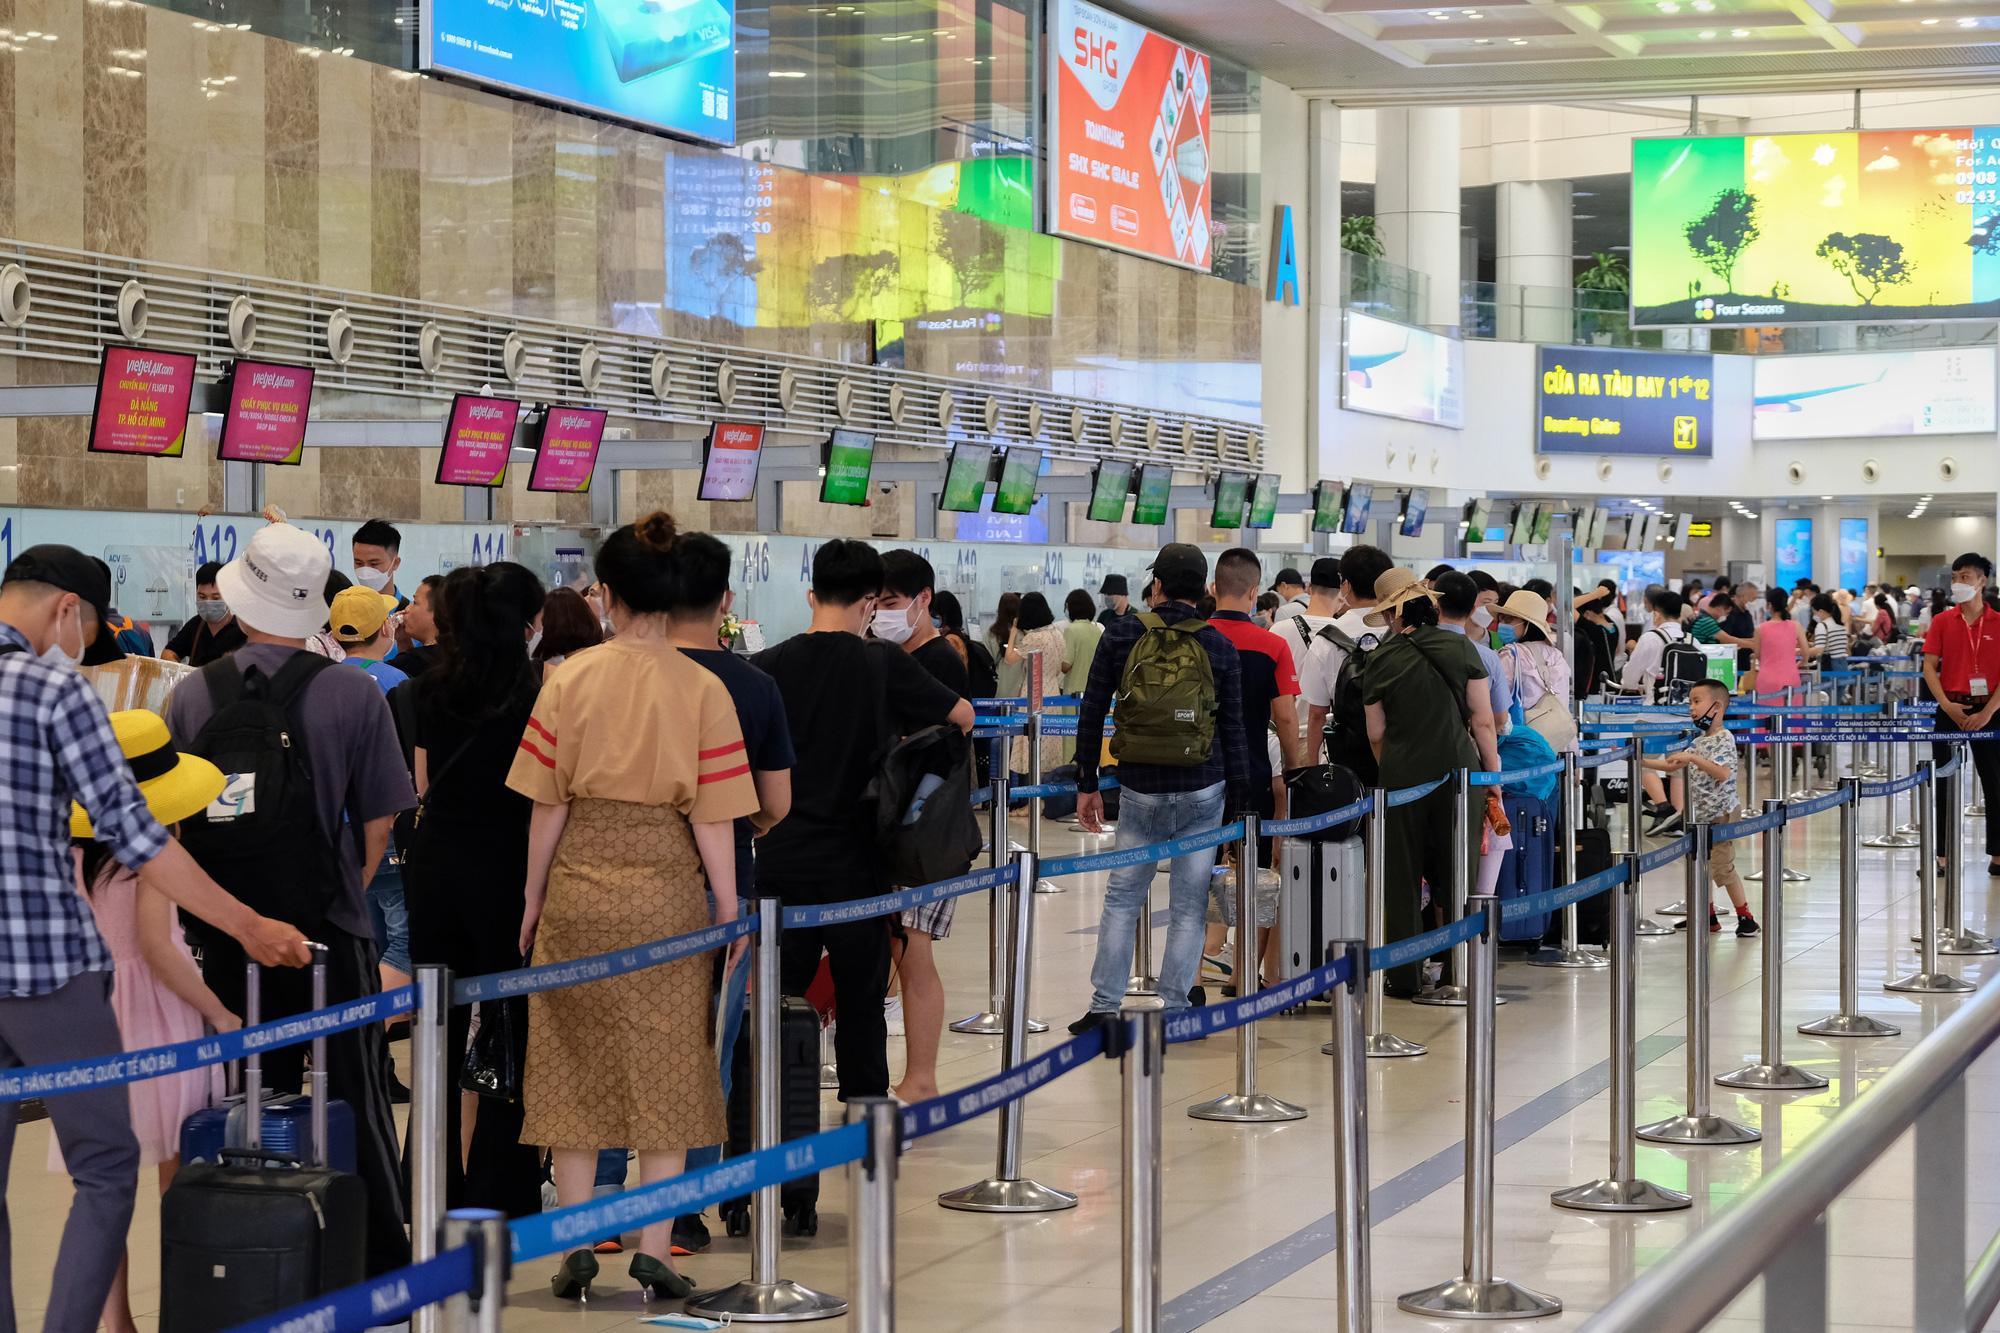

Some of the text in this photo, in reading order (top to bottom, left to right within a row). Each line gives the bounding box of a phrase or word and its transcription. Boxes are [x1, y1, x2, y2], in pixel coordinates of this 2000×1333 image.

[1075, 26, 1117, 79] SHG
[1956, 155, 1984, 167] For
[1955, 171, 1997, 185] 0908
[1274, 204, 1300, 305] A
[1716, 302, 1785, 317] Four Seasons
[167, 385, 175, 395] TO
[1544, 365, 1665, 398] CỬA RA TÀU BAY
[149, 416, 167, 429] MINH
[194, 523, 237, 566] A12
[742, 542, 769, 583] A16
[1044, 552, 1063, 585] A20
[54, 1064, 94, 1089] KHÔNG
[197, 1041, 222, 1061] N.I.A
[275, 1012, 340, 1042] INTERNATIONAL
[341, 1001, 377, 1024] AIRPORT
[392, 991, 413, 1009] N.I.A
[601, 1177, 702, 1227] INTERNATIONAL
[702, 1159, 757, 1196] AIRPORT
[785, 1144, 815, 1172] N.I.A
